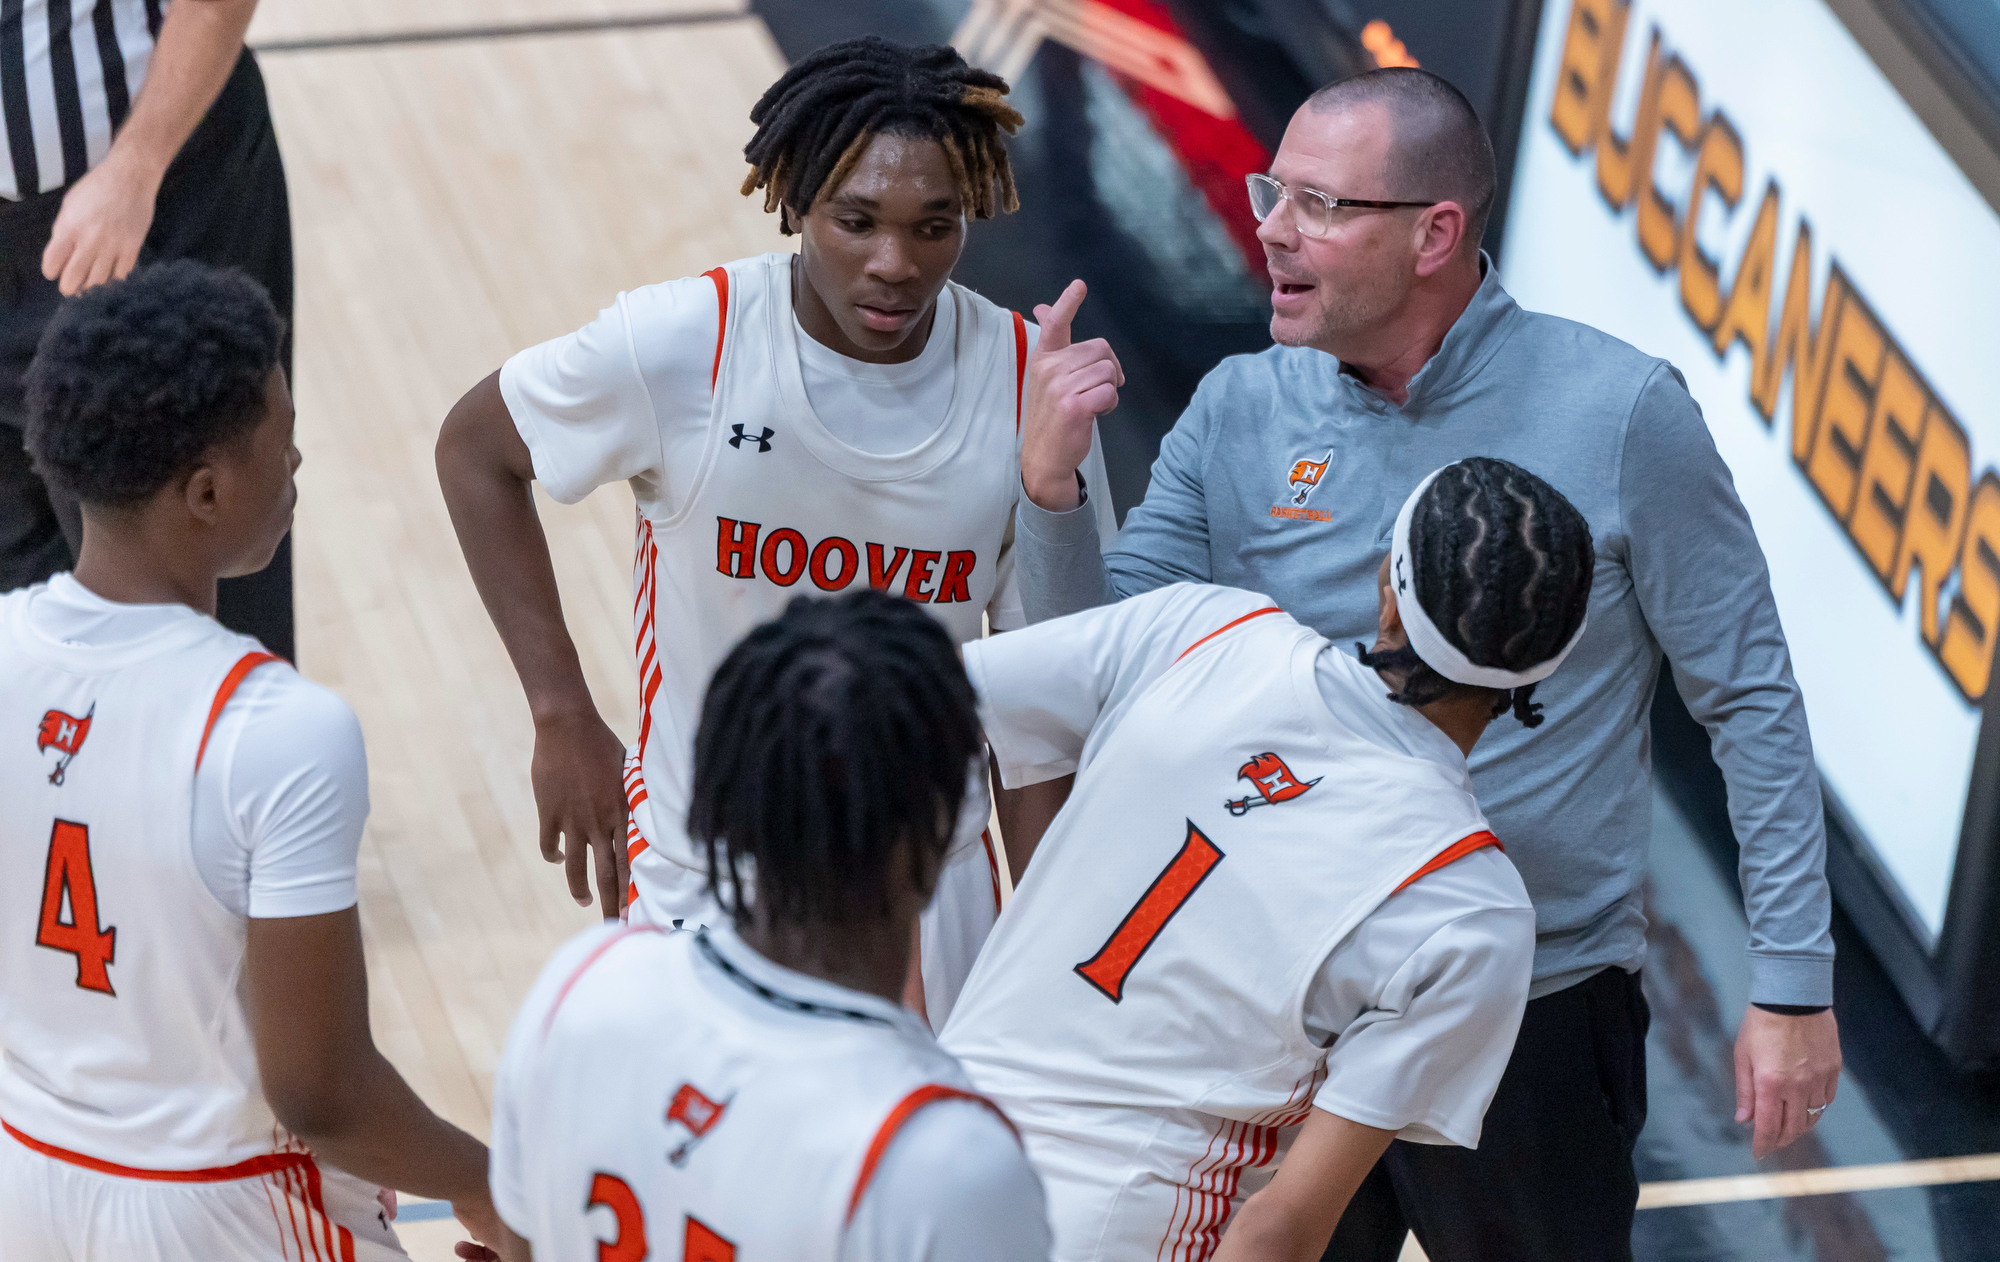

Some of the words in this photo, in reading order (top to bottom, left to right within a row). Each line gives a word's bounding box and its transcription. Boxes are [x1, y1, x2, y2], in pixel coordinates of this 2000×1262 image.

[1549, 0, 2000, 706] BUCCANEERS
[1270, 506, 1333, 521] BASKETBALL
[1301, 465, 1319, 482] H
[716, 516, 977, 604] HOOVER
[55, 720, 78, 747] H
[1258, 767, 1296, 798] H
[35, 818, 118, 998] 4
[1072, 816, 1227, 1006] 1
[584, 1169, 738, 1262] 3
